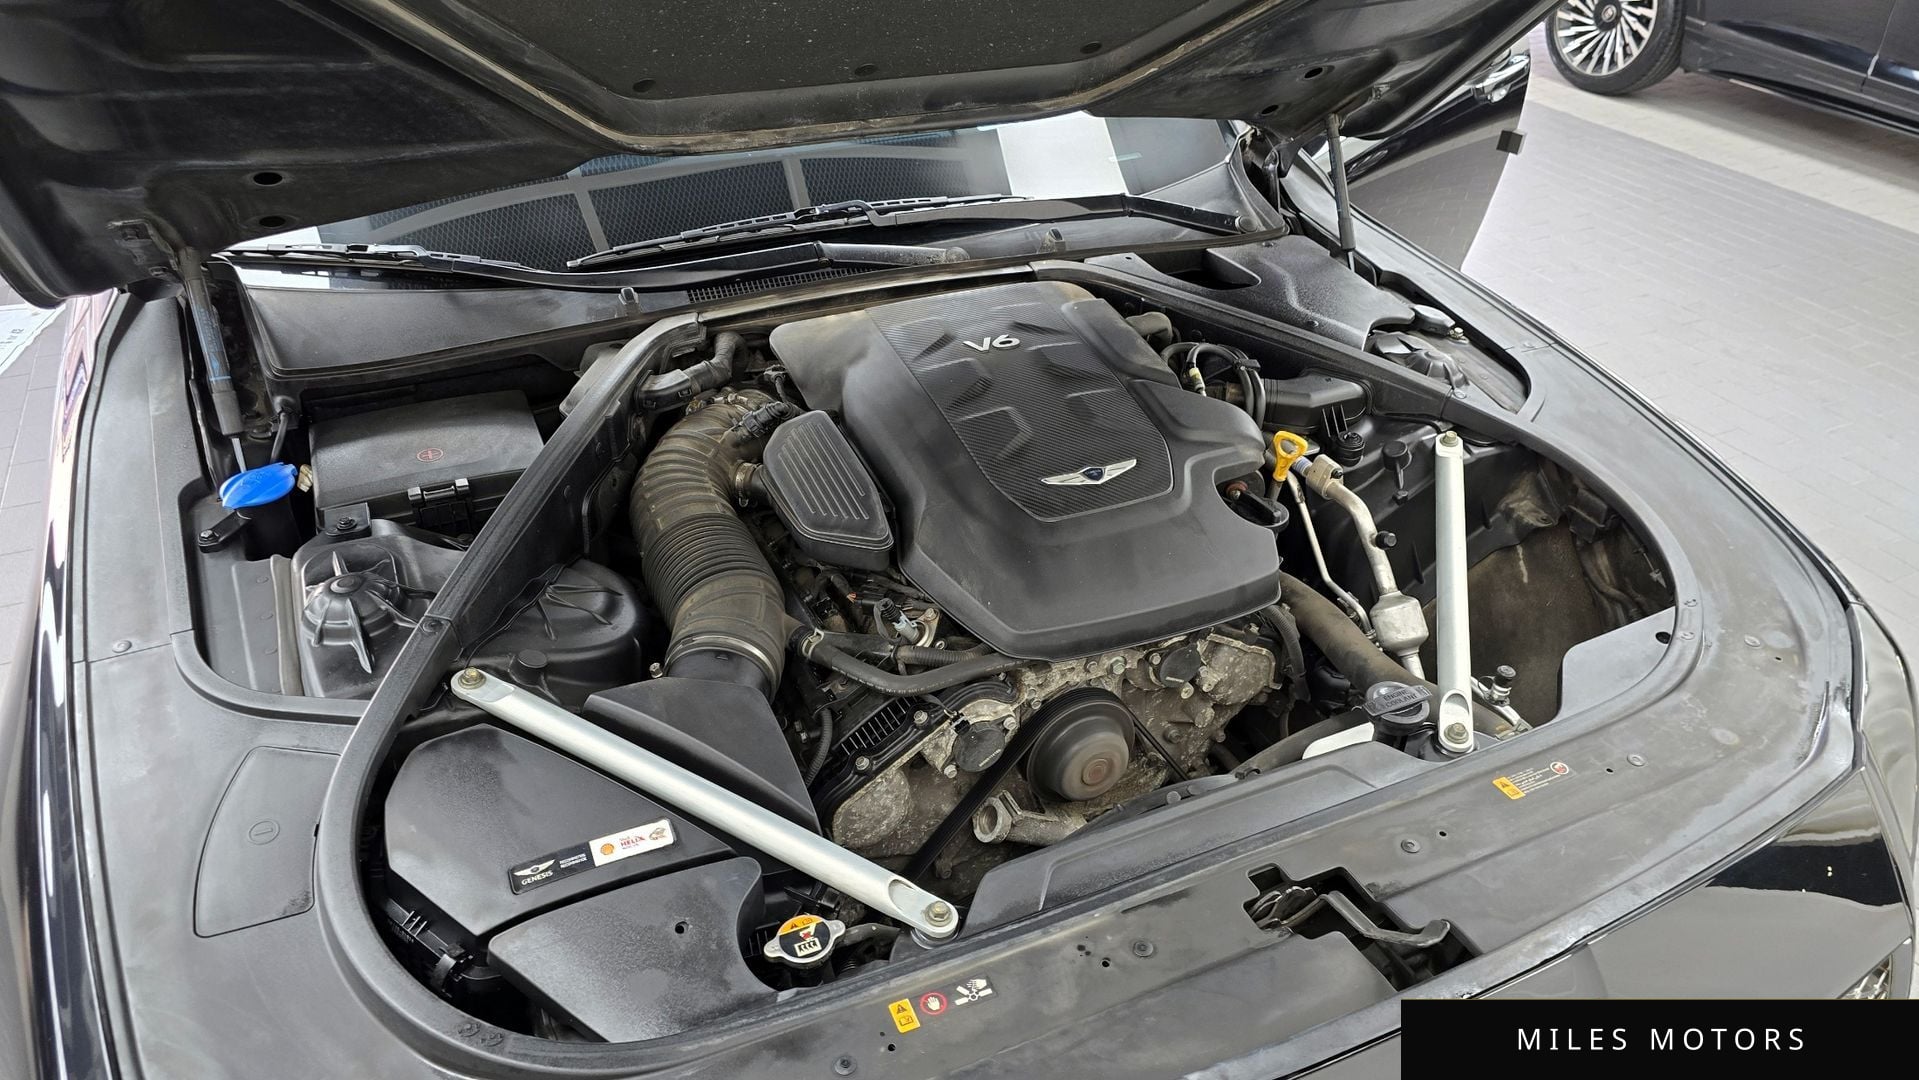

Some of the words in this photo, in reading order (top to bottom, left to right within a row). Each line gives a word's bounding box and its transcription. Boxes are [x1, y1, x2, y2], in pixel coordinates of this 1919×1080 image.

[962, 334, 1020, 353] V6
[620, 835, 646, 847] HELIX
[521, 870, 554, 886] GENESIS
